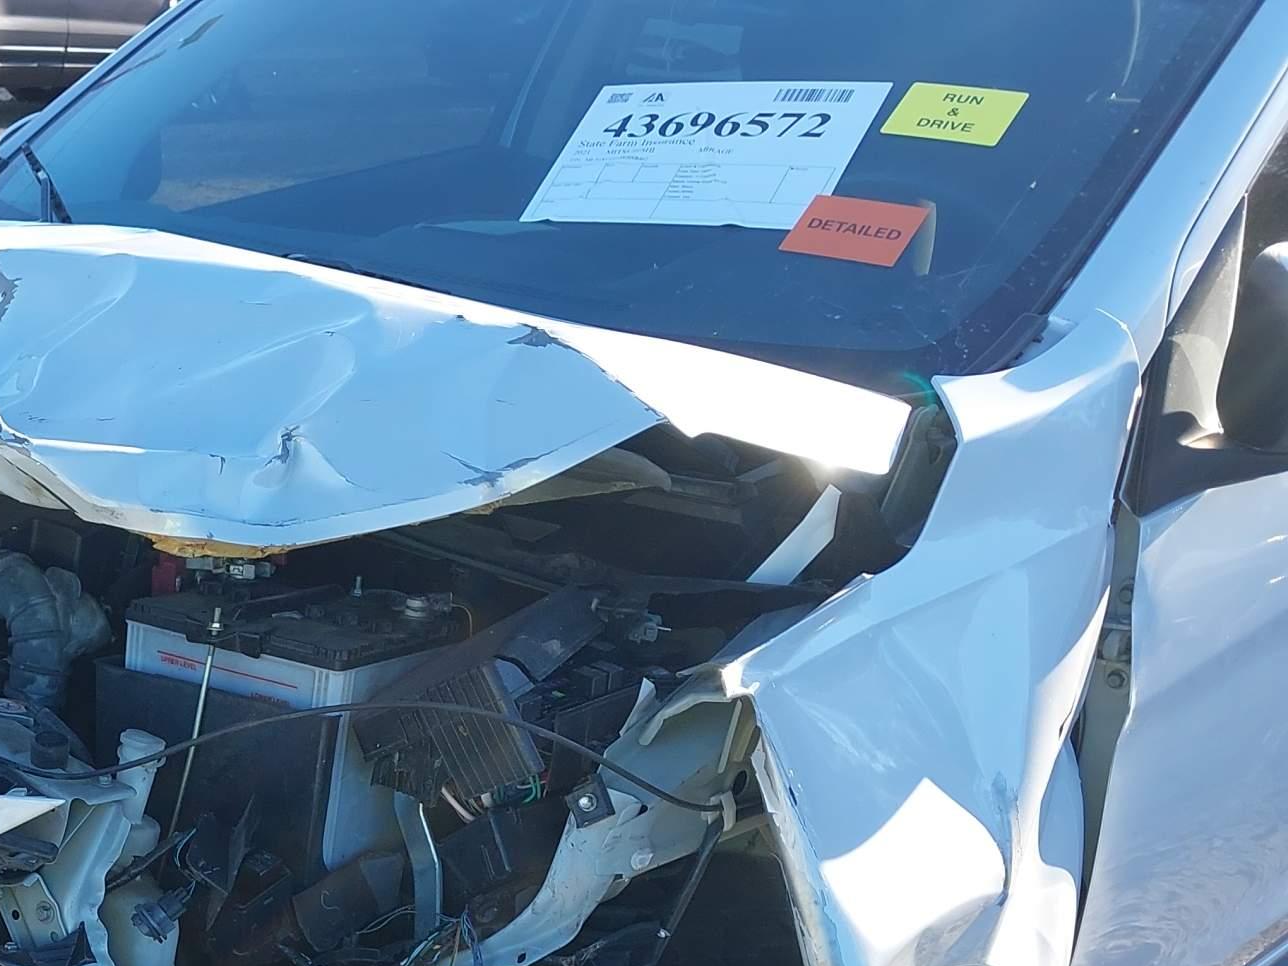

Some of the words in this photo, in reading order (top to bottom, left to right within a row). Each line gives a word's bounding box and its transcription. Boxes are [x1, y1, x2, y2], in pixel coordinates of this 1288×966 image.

[943, 93, 984, 105] RUN
[947, 107, 960, 117] &
[603, 111, 832, 138] 43696572
[916, 117, 975, 133] DRIVE
[578, 140, 606, 148] State
[608, 139, 638, 147] Farm
[807, 217, 902, 241] DETAILED
